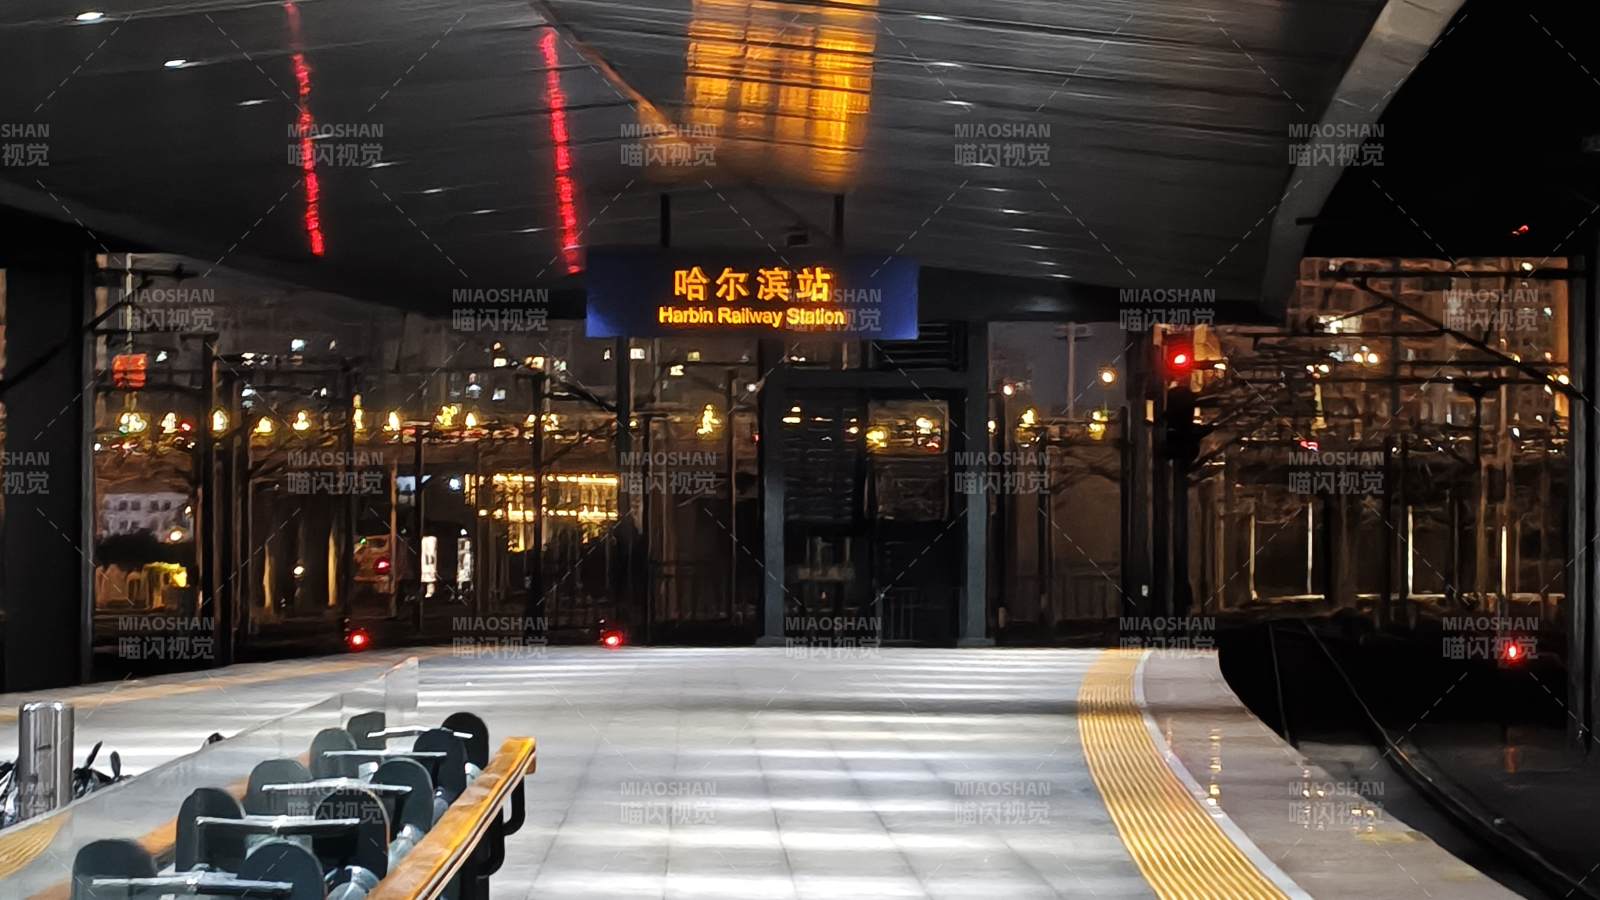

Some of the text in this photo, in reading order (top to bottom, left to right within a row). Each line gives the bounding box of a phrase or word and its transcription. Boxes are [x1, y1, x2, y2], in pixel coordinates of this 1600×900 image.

[674, 266, 832, 301] 哈尔滨站
[658, 307, 845, 328] Harbin Railway Station
